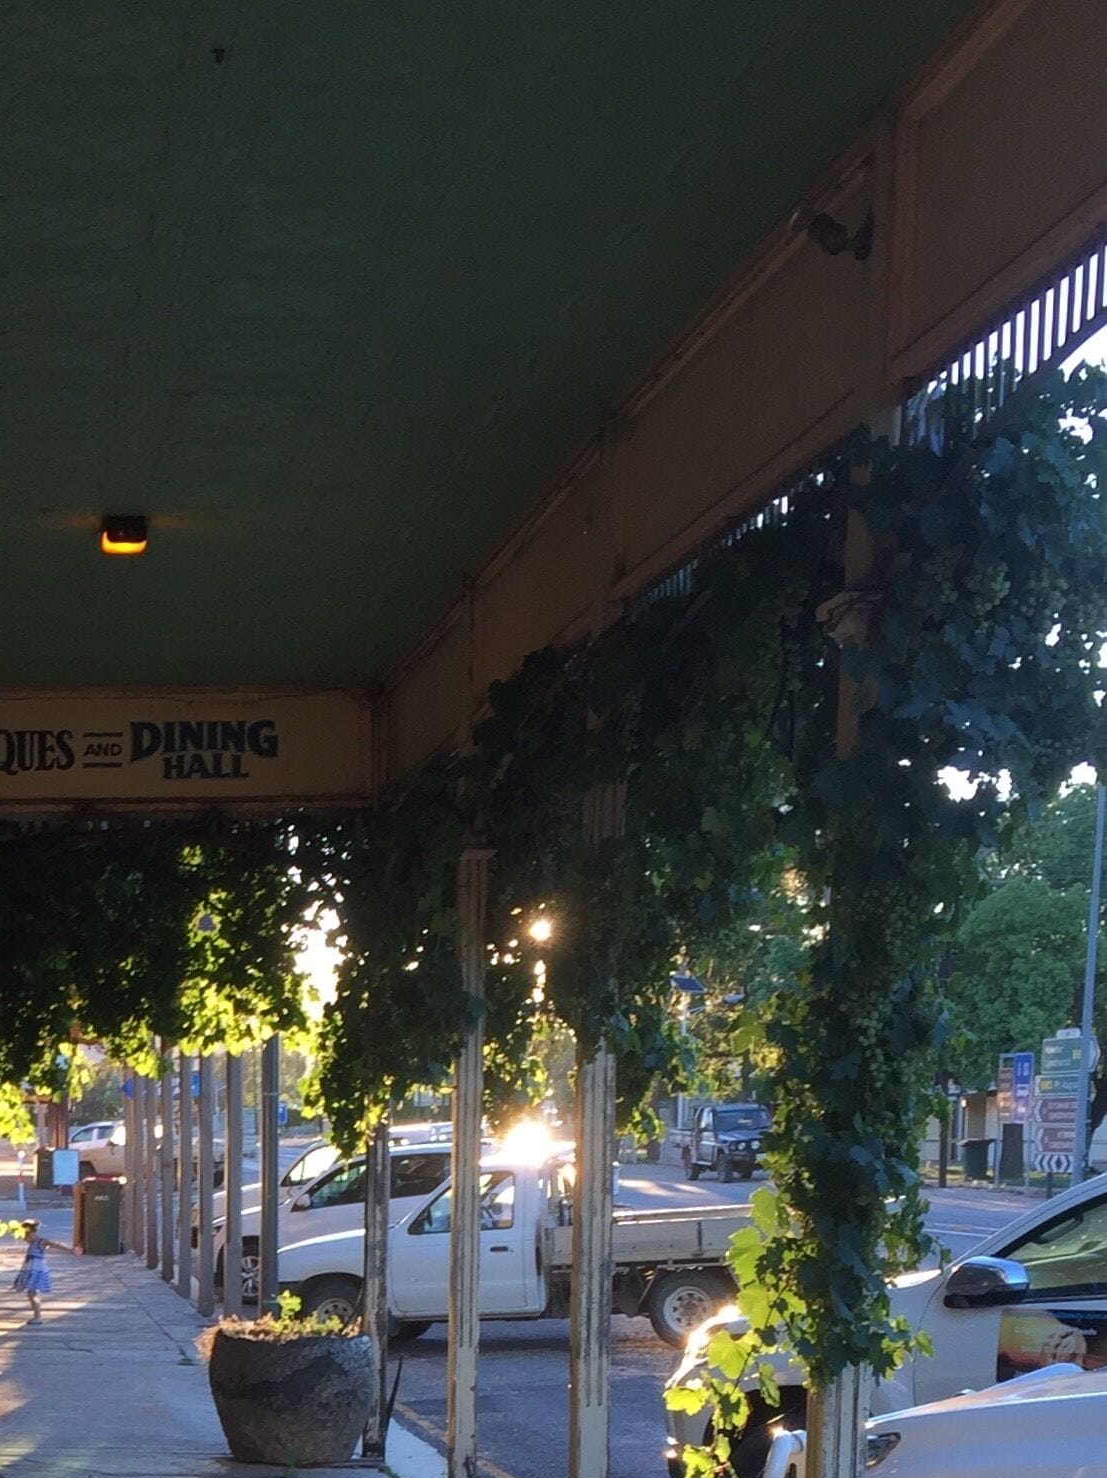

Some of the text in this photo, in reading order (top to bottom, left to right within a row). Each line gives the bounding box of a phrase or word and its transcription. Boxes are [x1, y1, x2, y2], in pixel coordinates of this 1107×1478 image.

[83, 743, 123, 757] AND
[130, 719, 279, 763] DINING
[162, 752, 249, 780] HALL
